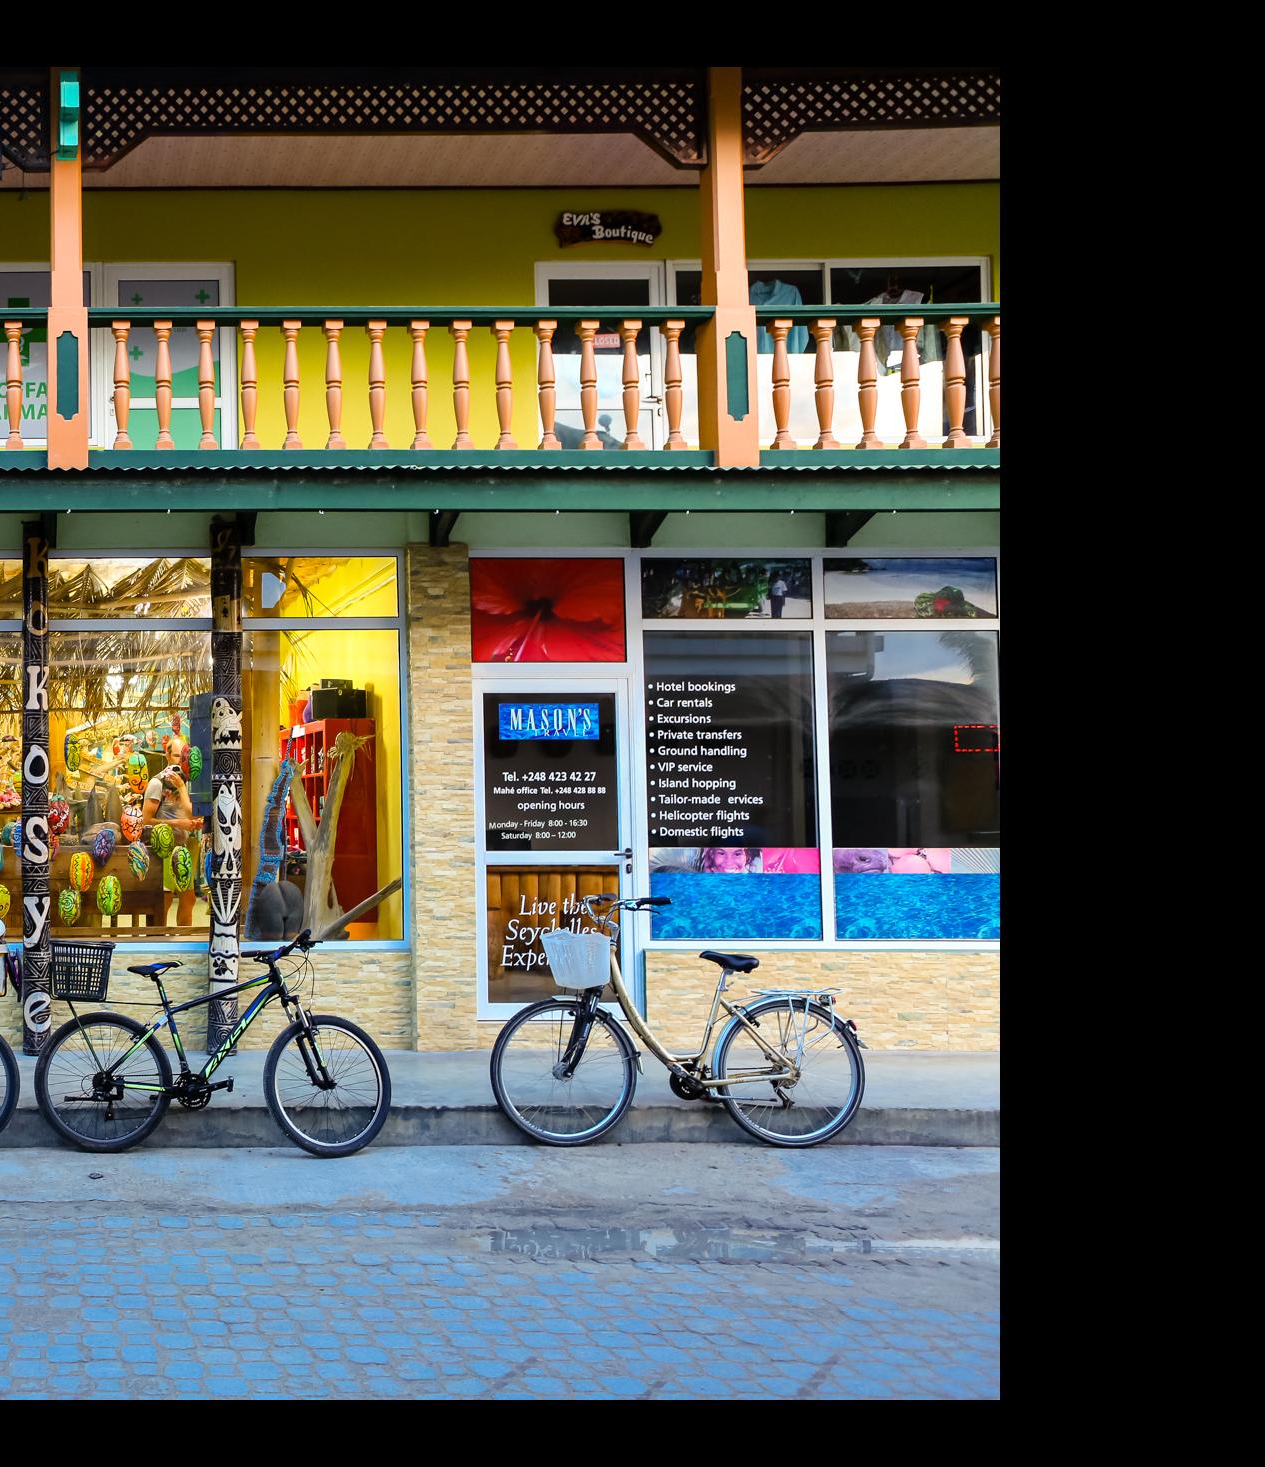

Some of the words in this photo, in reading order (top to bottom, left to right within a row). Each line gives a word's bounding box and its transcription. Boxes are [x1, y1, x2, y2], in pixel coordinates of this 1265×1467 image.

[592, 225, 654, 244] Boutique
[594, 335, 620, 346] LOSED
[656, 682, 684, 692] Hotel
[688, 682, 736, 694] bookings
[656, 697, 674, 708] Car
[677, 697, 713, 708] rentals
[510, 708, 592, 731] MASON'S
[657, 713, 712, 724] Excursions
[534, 728, 589, 737] TRAVEL
[657, 729, 694, 740] Private
[696, 729, 742, 740] transfers
[658, 745, 698, 756] Ground
[700, 745, 747, 758] handling
[658, 762, 675, 772] VIP
[677, 762, 713, 772] service
[502, 772, 519, 782] Tel.
[522, 772, 546, 782] +248
[548, 772, 567, 782] 423
[569, 772, 582, 782] 42
[584, 772, 596, 782] 27
[658, 778, 690, 788] Island
[691, 778, 736, 790] hopping
[493, 786, 515, 795] Mahé
[516, 787, 538, 795] office
[540, 787, 553, 795] Tel.
[555, 787, 572, 795] +248
[573, 787, 586, 795] 428
[587, 787, 596, 795] 88
[597, 787, 606, 795] 88
[658, 794, 721, 804] Tailor-made
[517, 800, 557, 812] opening
[558, 800, 585, 810] hours
[659, 810, 714, 822] Helicopter
[716, 810, 750, 822] flights
[488, 820, 518, 829] Monday
[523, 820, 545, 828] Friday
[548, 819, 563, 827] 8:00
[569, 819, 588, 827] 16:30
[501, 832, 532, 840] Saturday
[659, 826, 709, 837] Domestic
[710, 826, 744, 838] flights
[518, 895, 557, 916] Live
[563, 893, 589, 915] the
